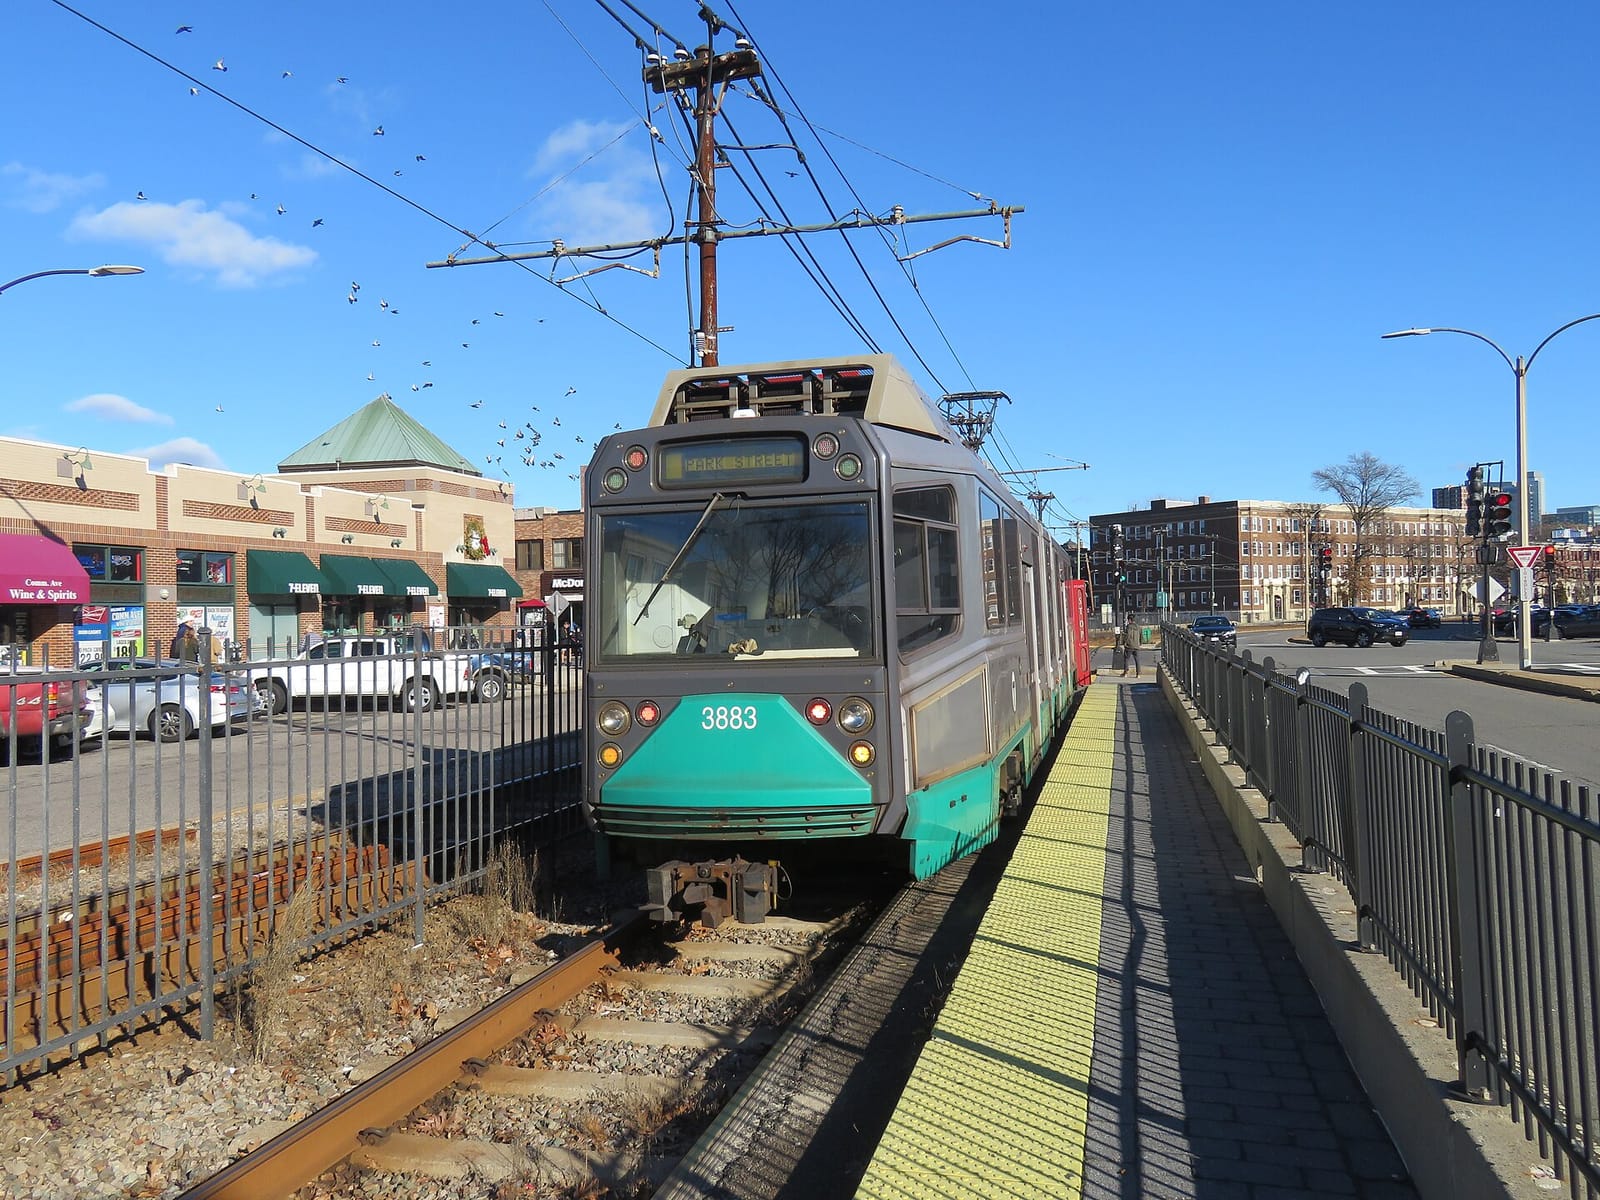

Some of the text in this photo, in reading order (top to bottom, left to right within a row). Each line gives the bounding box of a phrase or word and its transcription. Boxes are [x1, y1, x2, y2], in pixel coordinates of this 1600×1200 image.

[686, 454, 793, 472] PARK STREET
[50, 579, 63, 587] Ave
[9, 588, 77, 602] Wine & Spirits
[701, 706, 758, 730] 3883
